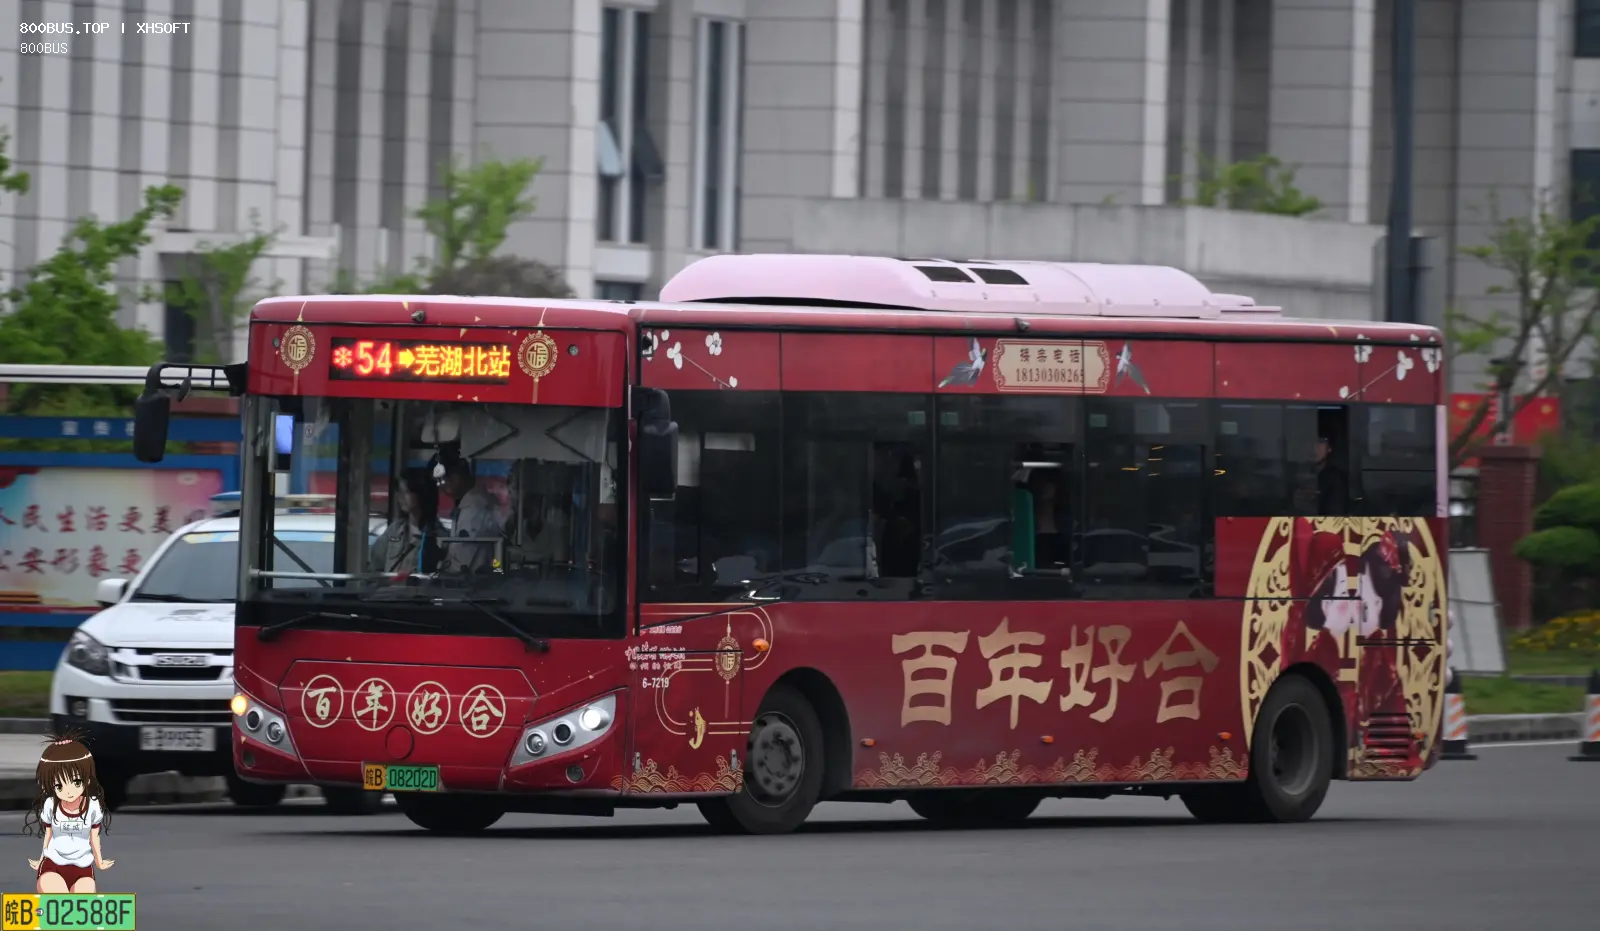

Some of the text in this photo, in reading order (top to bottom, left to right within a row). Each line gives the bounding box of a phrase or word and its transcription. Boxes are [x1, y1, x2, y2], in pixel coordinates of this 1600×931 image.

[357, 342, 392, 376] 54
[415, 344, 511, 377] 芜湖北站
[642, 677, 670, 689] 6-7219
[892, 616, 1220, 730] 百年好合
[307, 681, 503, 732] 百年好合
[365, 767, 437, 789] 皖B 08202D
